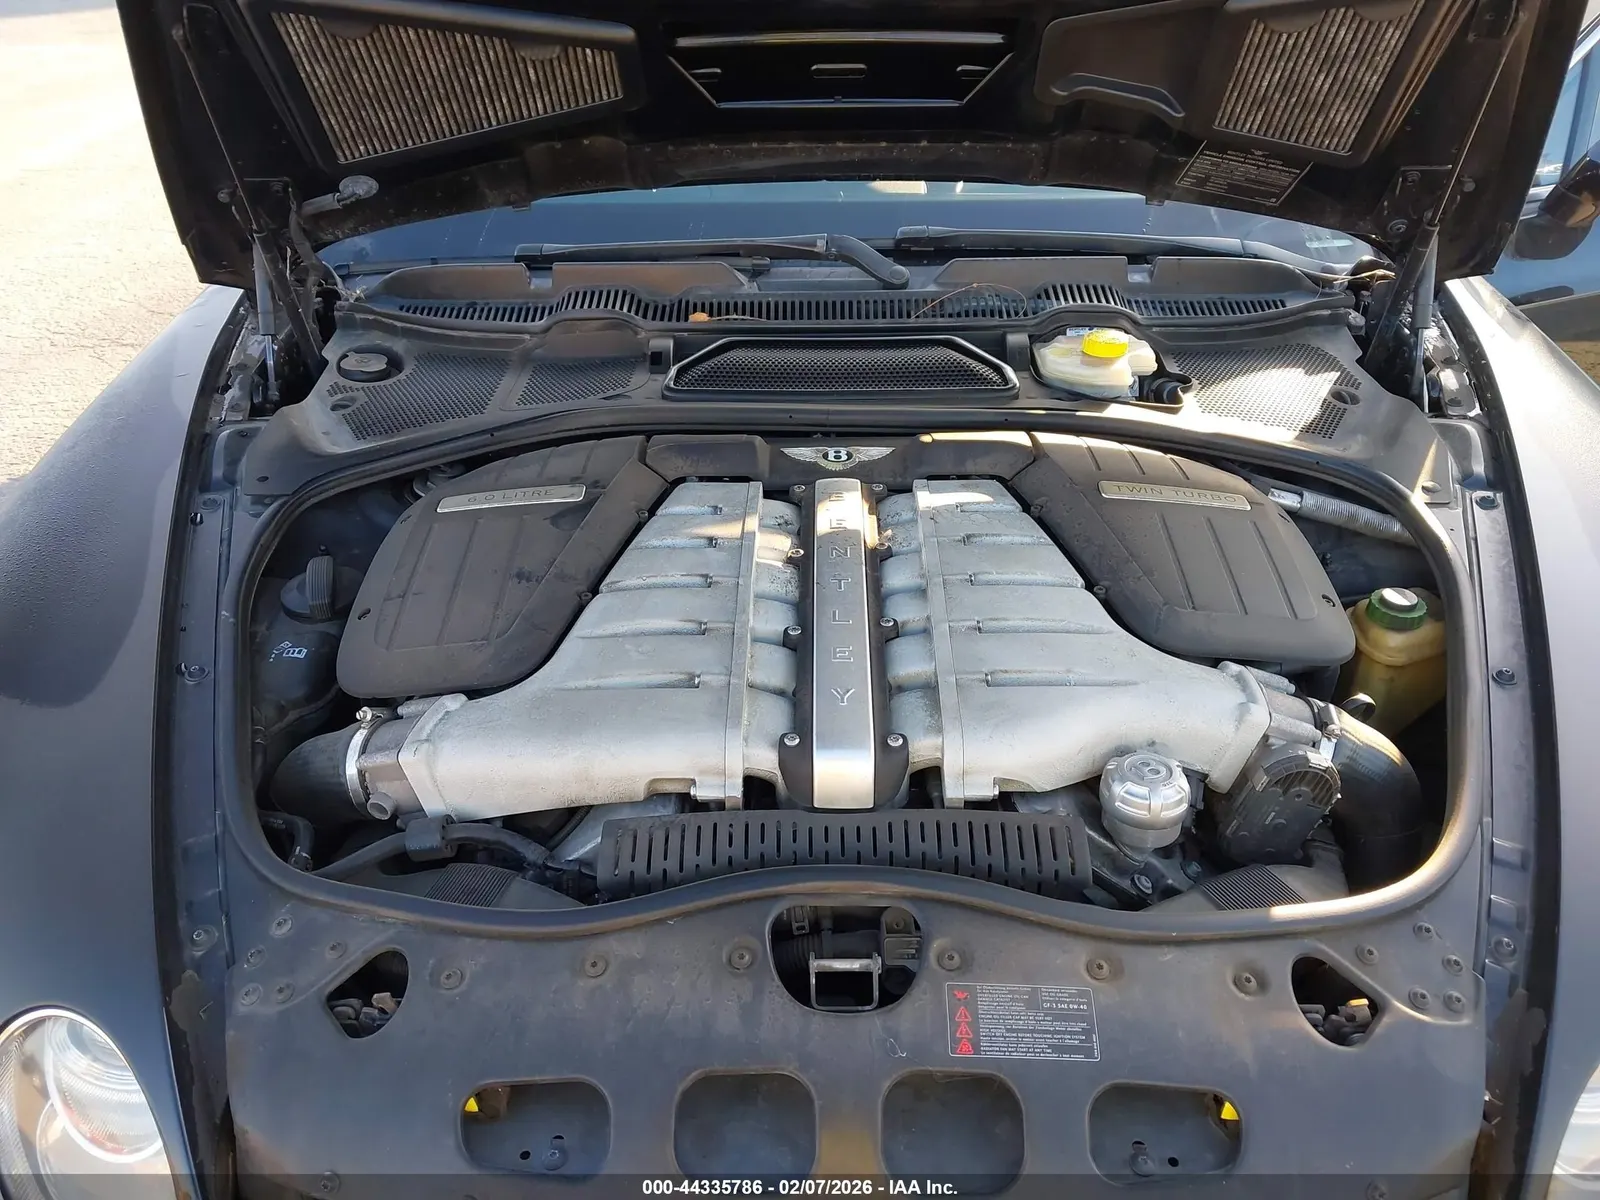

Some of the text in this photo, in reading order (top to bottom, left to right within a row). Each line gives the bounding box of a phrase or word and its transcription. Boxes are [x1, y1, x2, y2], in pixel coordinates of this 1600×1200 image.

[826, 448, 848, 462] B
[467, 488, 555, 503] 6.0 LITRE
[1113, 484, 1237, 503] TWIN TURBO
